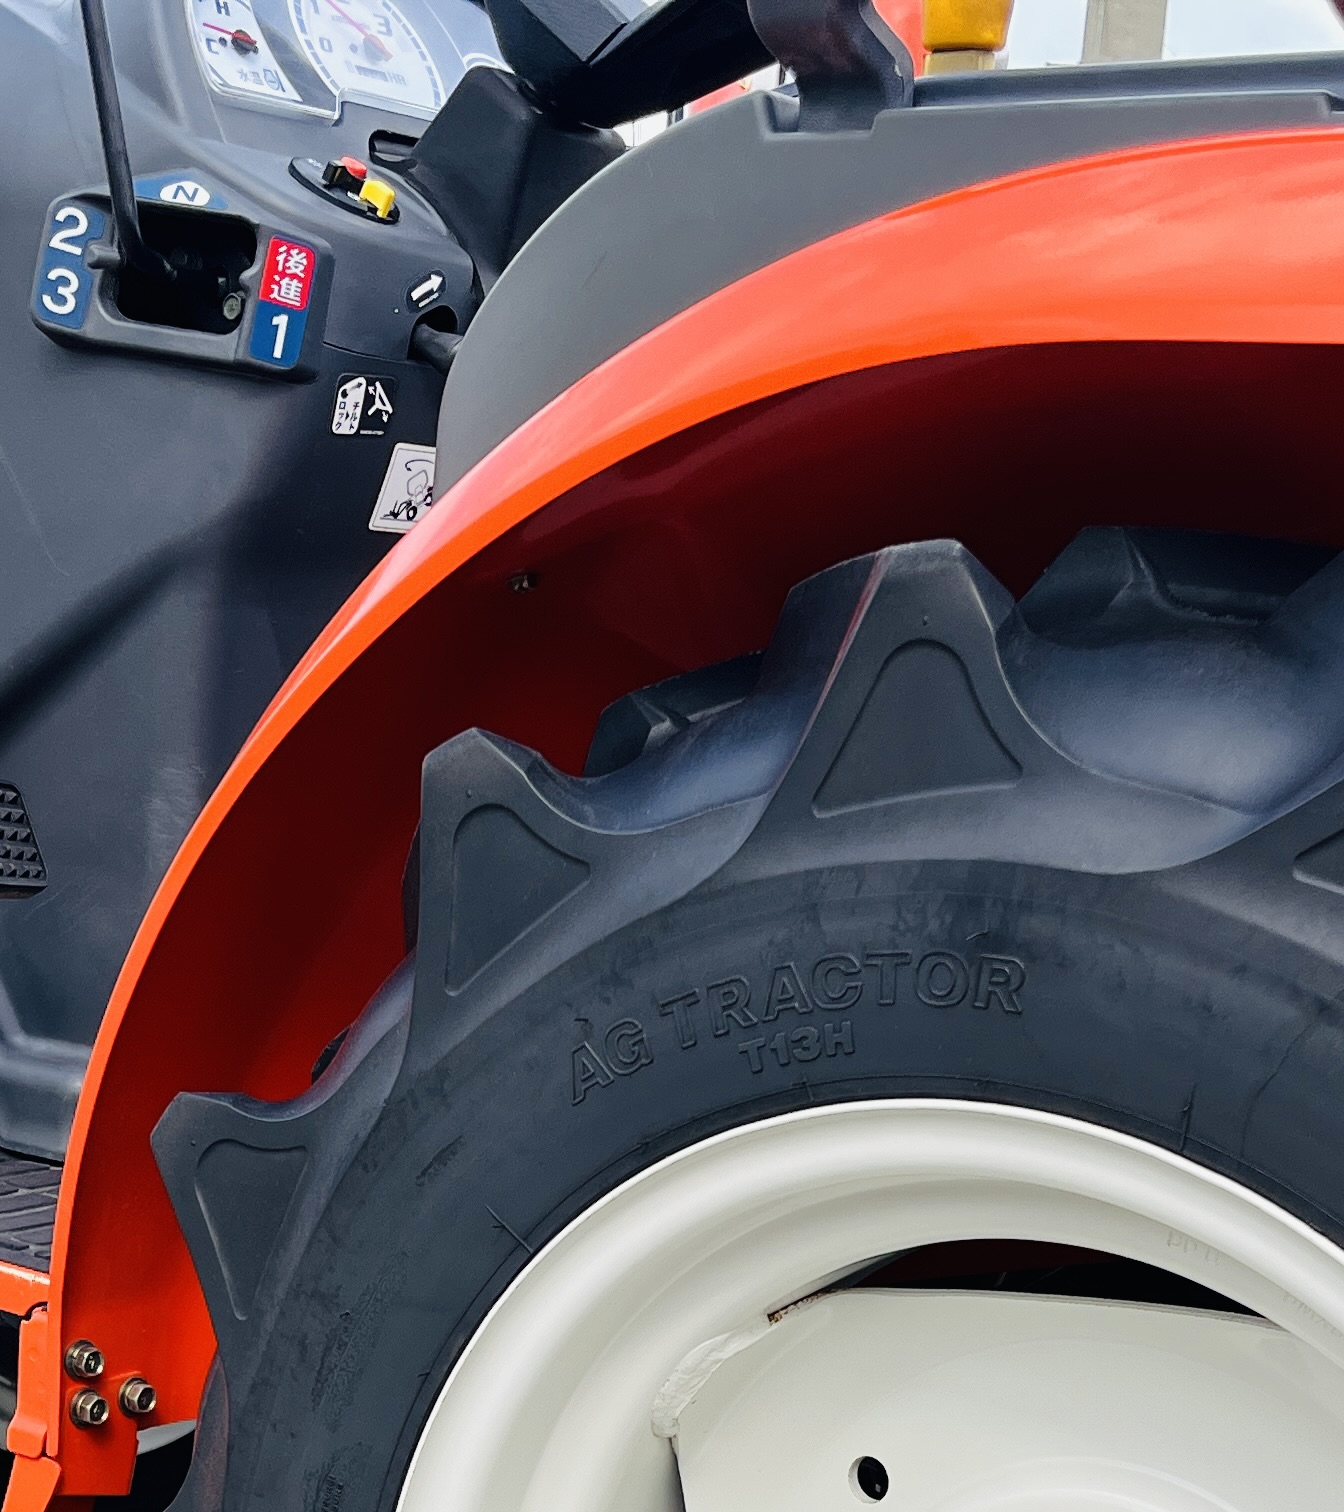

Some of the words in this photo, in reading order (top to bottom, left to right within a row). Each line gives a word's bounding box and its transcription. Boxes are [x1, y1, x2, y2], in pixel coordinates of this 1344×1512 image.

[171, 184, 199, 203] N
[48, 206, 89, 256] 2
[42, 267, 80, 315] 3
[269, 245, 308, 308] 後進
[271, 313, 289, 359] 1
[569, 1018, 653, 1106] AG
[660, 951, 1027, 1050] TRACTOR
[739, 1019, 855, 1074] T13H
